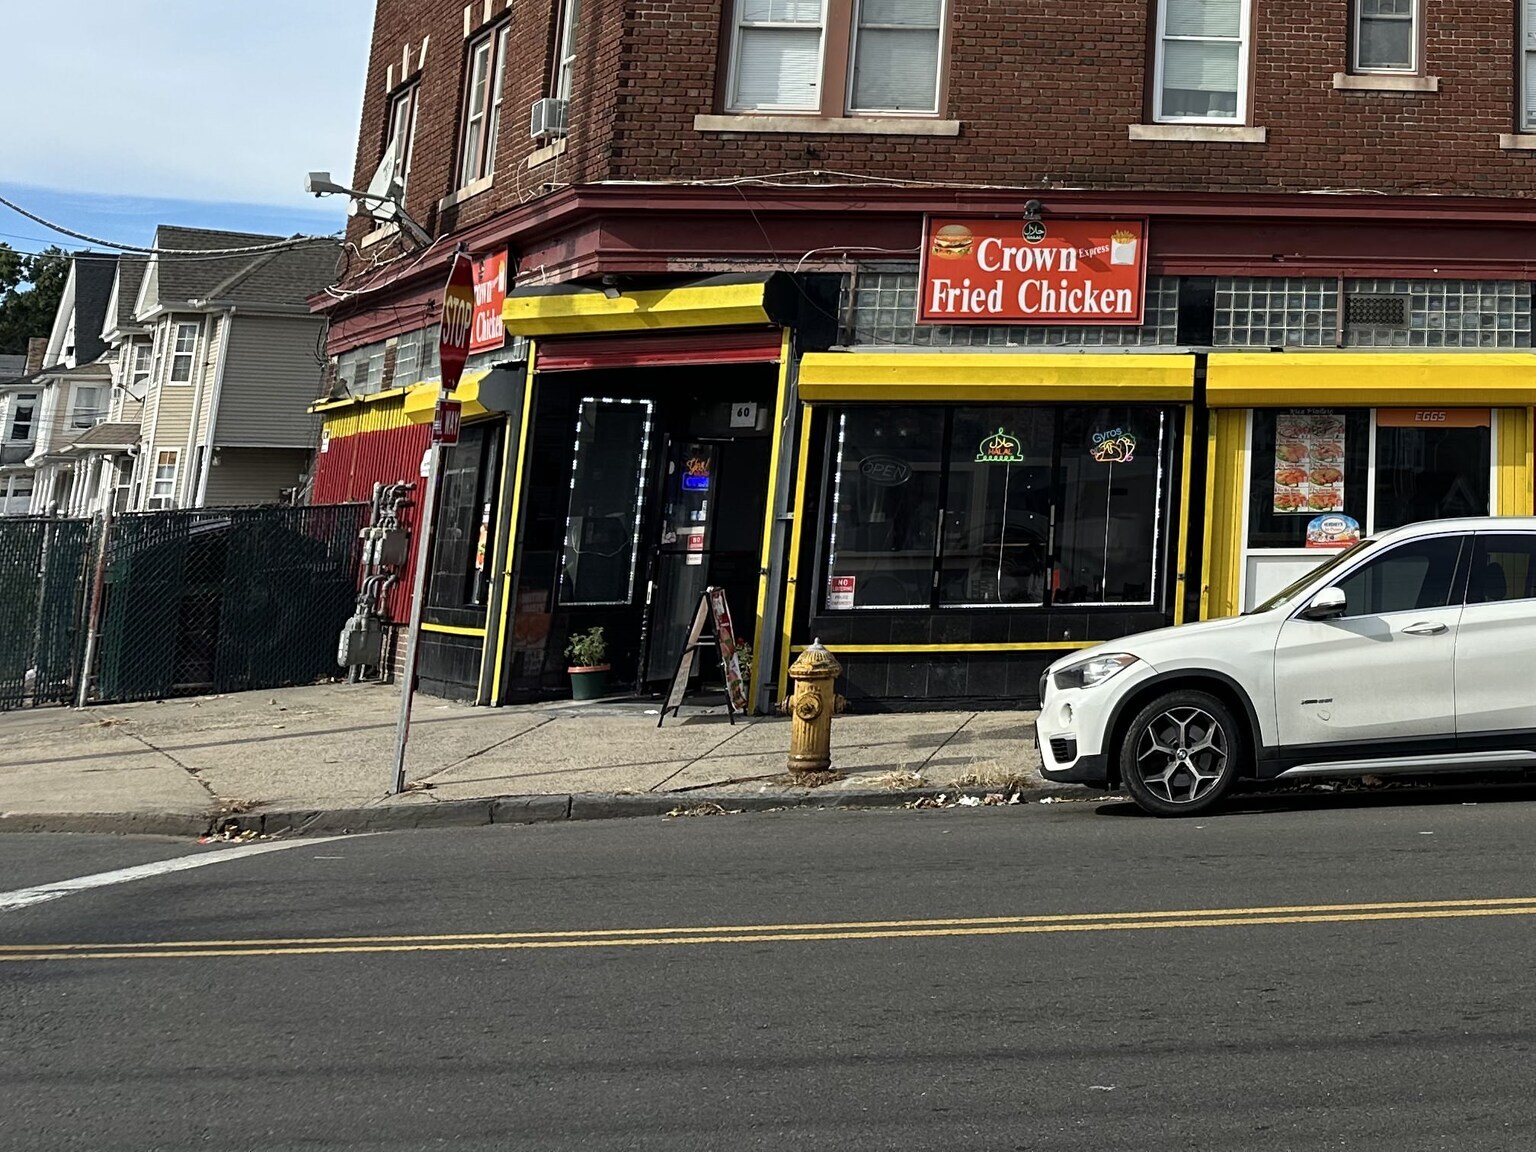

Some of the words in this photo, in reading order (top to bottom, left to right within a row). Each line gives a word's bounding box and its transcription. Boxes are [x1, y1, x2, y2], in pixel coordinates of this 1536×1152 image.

[977, 237, 1078, 272] Crown
[1079, 244, 1110, 258] Express
[929, 278, 1004, 313] Fried
[1018, 279, 1133, 314] Chicken
[442, 295, 472, 348] STOP
[737, 408, 750, 417] 60
[1415, 411, 1446, 421] EGGS
[444, 410, 460, 435] WAY
[1092, 426, 1122, 443] Gyros
[862, 462, 907, 481] OPEN
